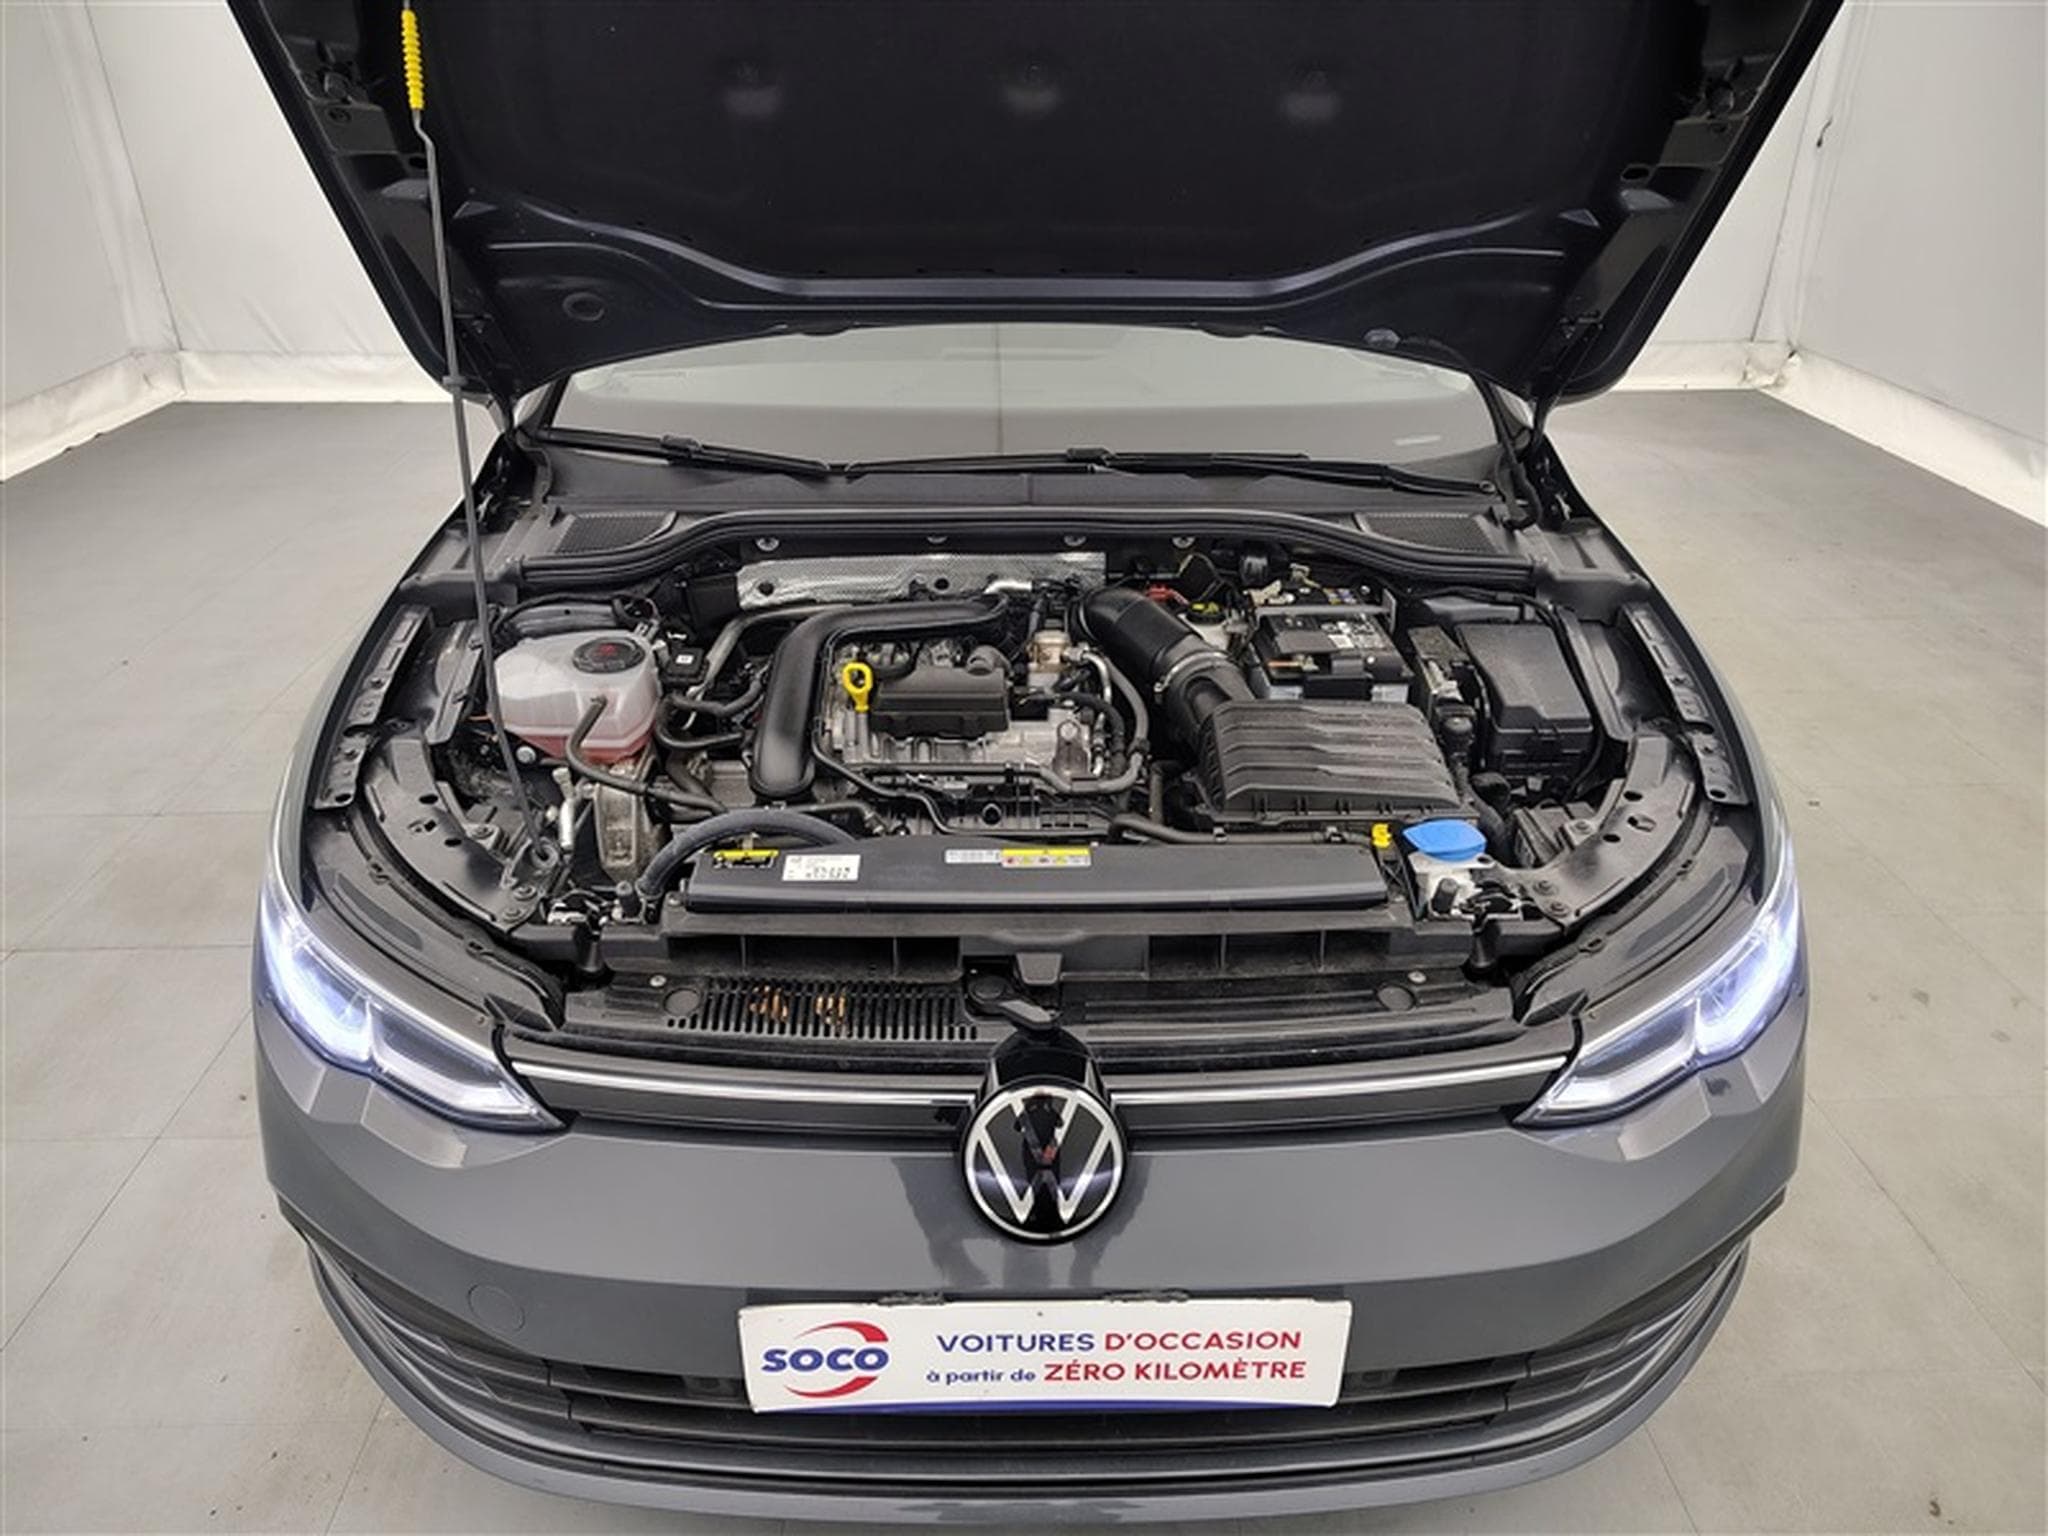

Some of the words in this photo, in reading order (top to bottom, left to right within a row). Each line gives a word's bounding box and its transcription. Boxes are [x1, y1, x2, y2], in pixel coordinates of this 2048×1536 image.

[937, 1333, 1095, 1353] VOITURES
[1104, 1331, 1302, 1352] D'OCCASION
[761, 1347, 889, 1373] SOCO
[926, 1368, 941, 1383] à
[945, 1367, 1004, 1386] partir
[1010, 1366, 1036, 1383] de
[1044, 1359, 1126, 1382] ZÉRO
[1134, 1356, 1306, 1381] KILOMÈTRE
